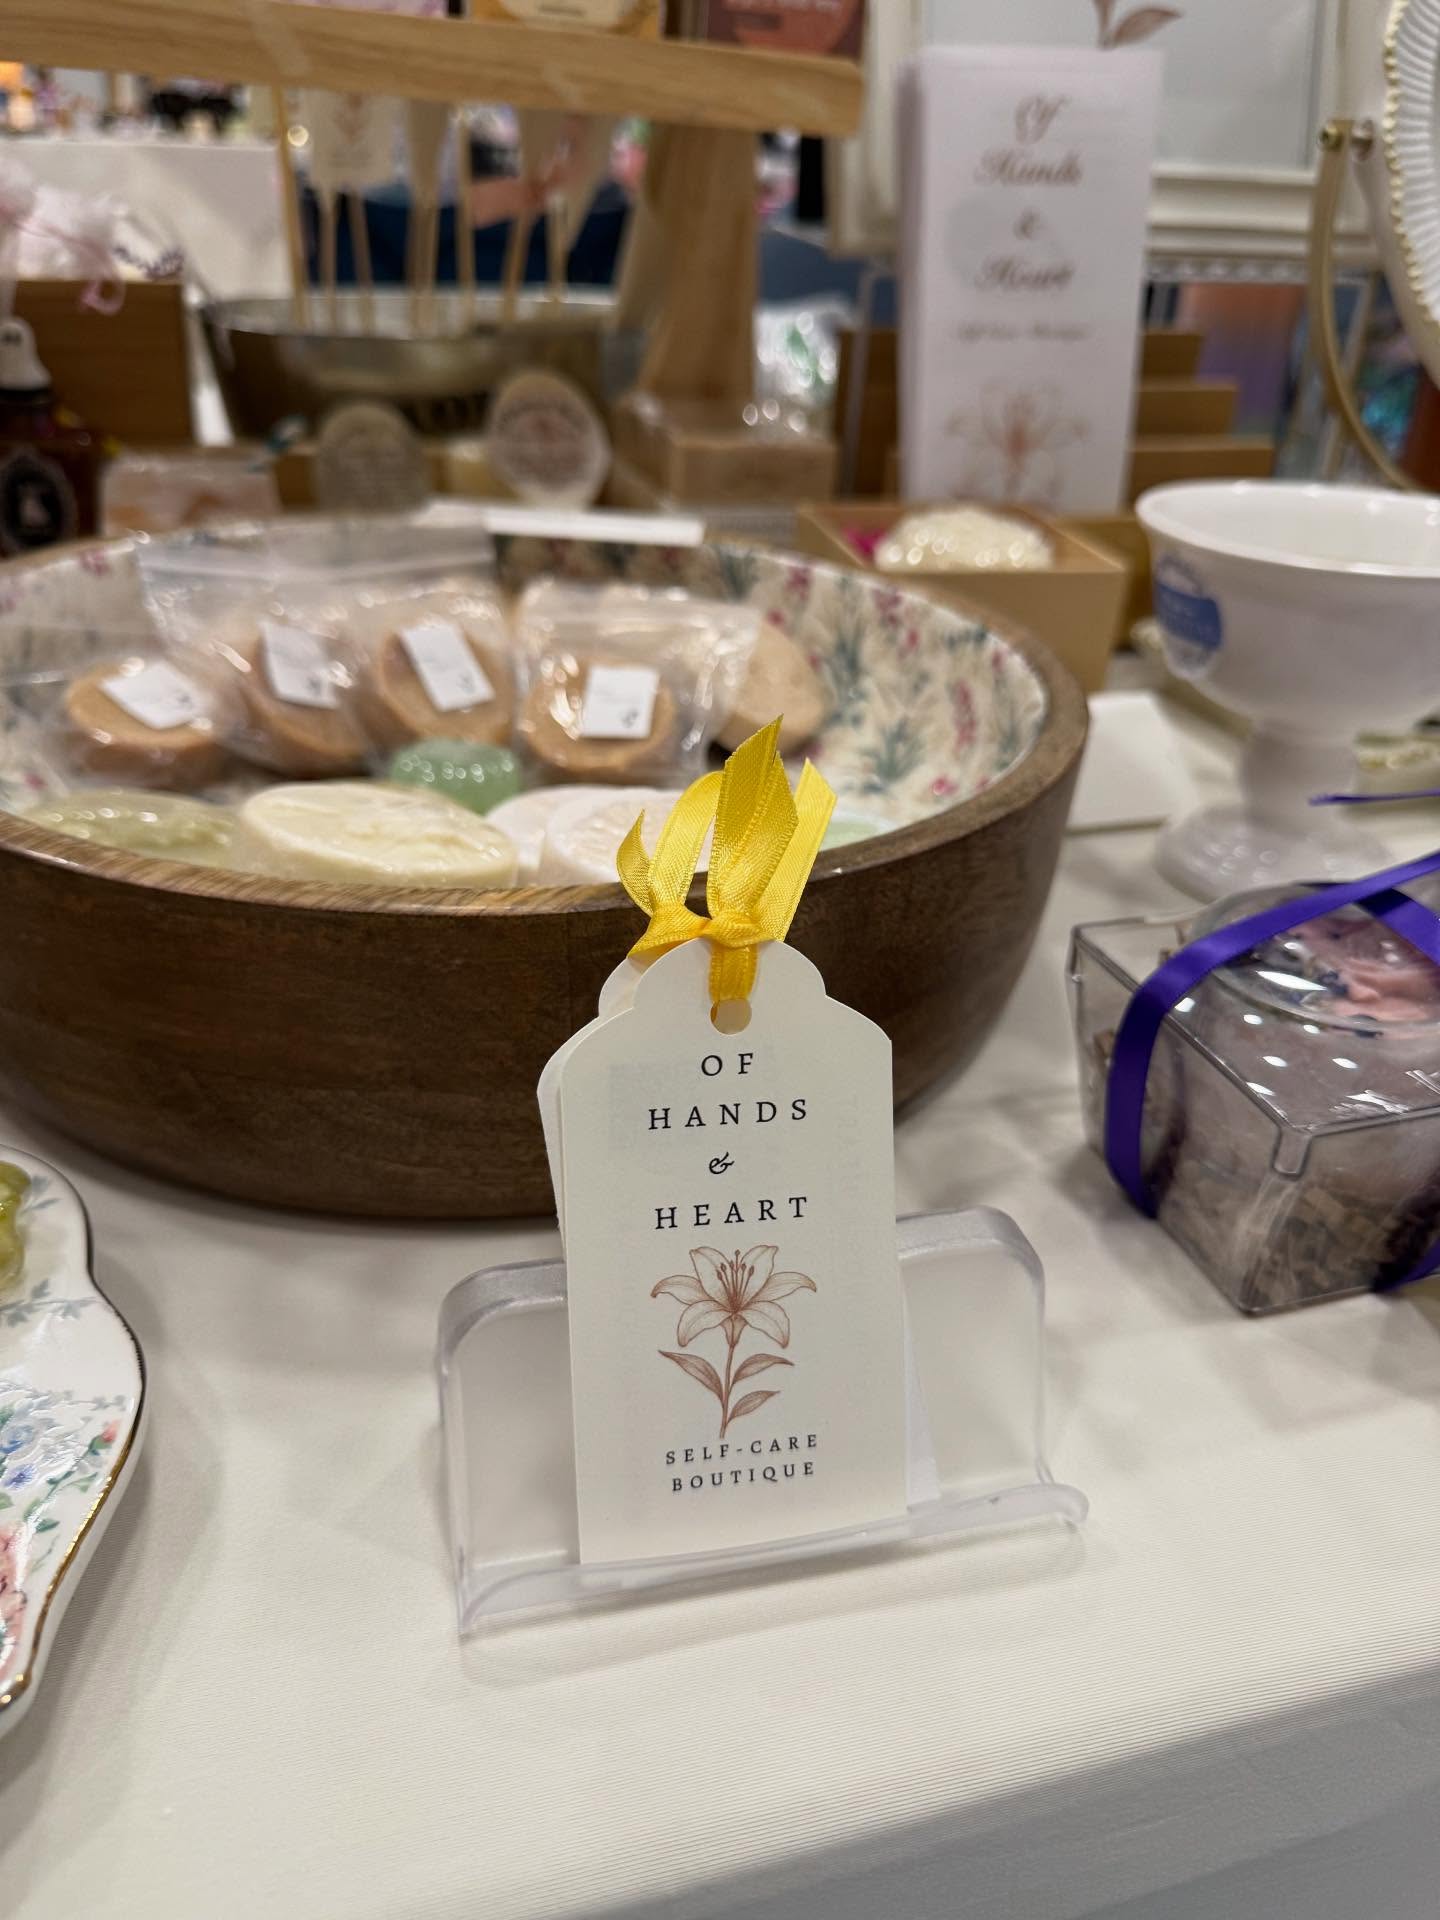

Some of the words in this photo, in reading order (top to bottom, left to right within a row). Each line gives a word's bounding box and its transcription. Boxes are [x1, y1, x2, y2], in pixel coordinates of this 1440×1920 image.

[700, 1052, 755, 1077] OF
[648, 1098, 808, 1131] HANDS
[708, 1151, 735, 1175] &
[655, 1196, 809, 1230] HEART
[665, 1434, 817, 1465] SELF-CARE
[672, 1461, 814, 1492] BOUTIQUE
